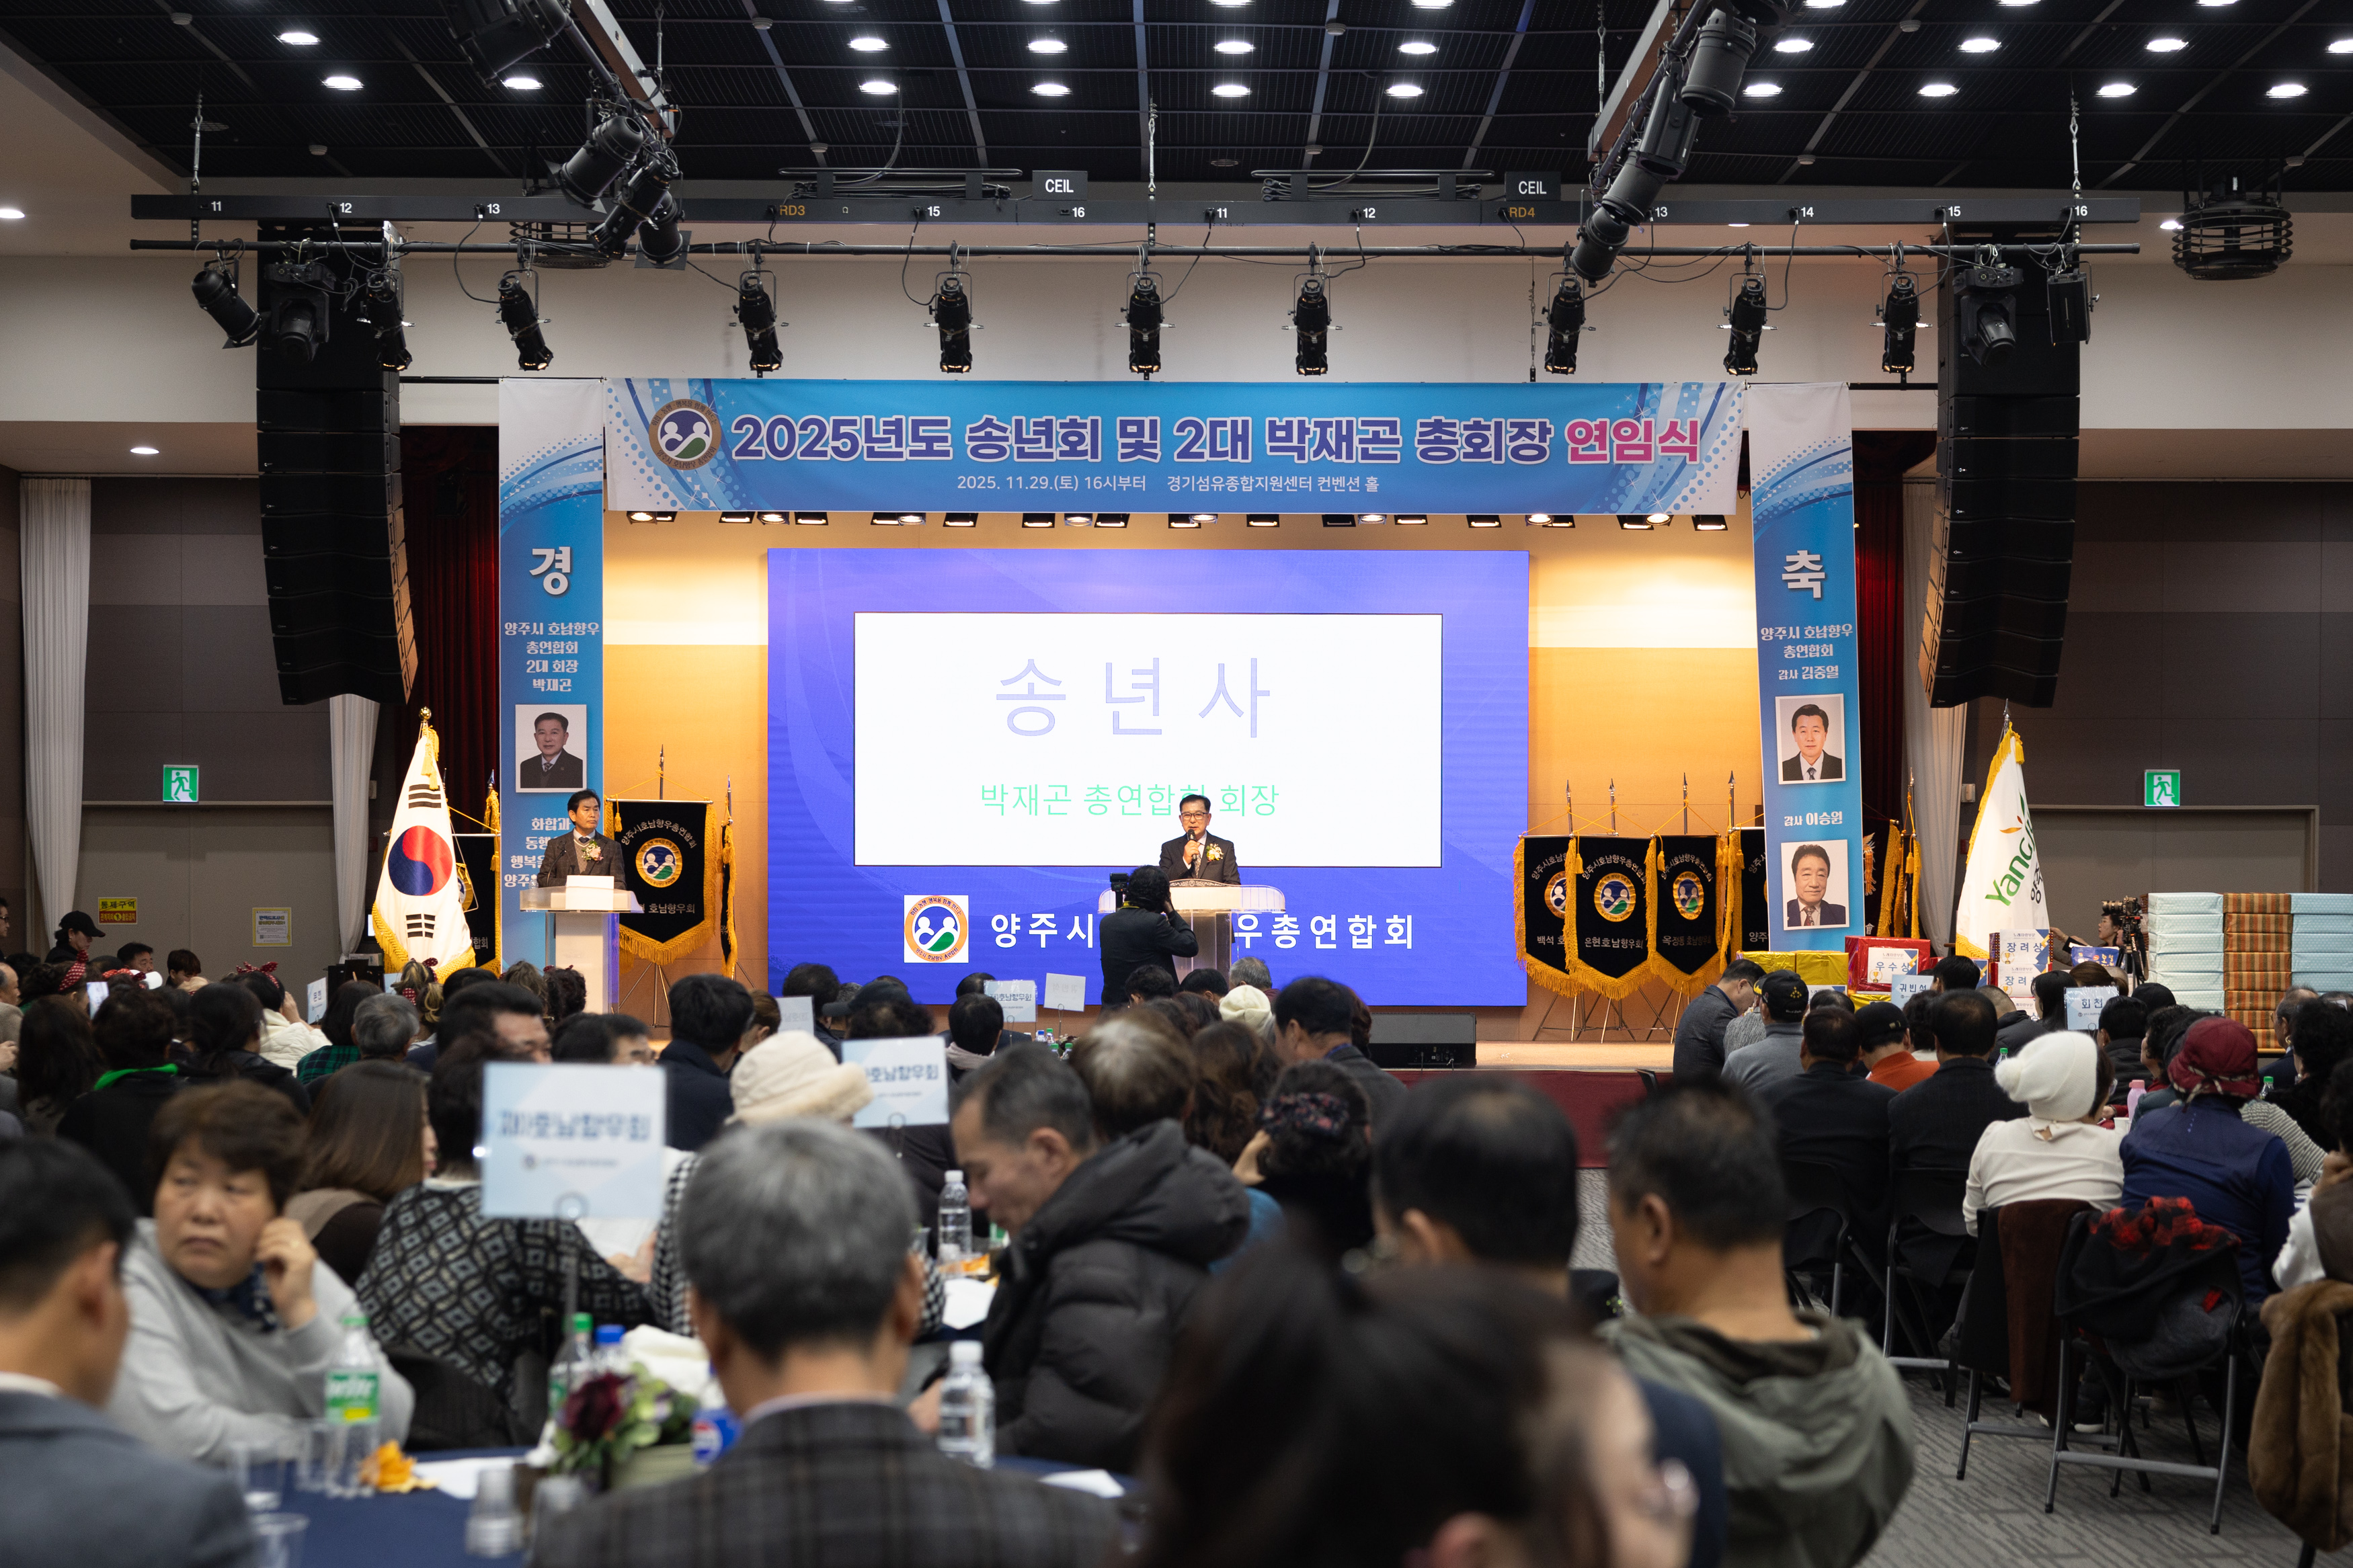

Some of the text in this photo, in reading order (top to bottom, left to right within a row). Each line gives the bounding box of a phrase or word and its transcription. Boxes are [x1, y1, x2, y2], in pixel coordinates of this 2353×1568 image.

[1045, 179, 1073, 194] CEIL
[1519, 180, 1547, 195] CEIL
[210, 202, 221, 212] 11
[340, 203, 352, 213] 12
[487, 204, 500, 214] 13
[780, 205, 805, 216] RD3
[927, 206, 940, 217] 15
[1072, 206, 1085, 217] 16
[1216, 207, 1228, 218] 11
[1363, 207, 1375, 218] 12
[1509, 206, 1536, 218] RD4
[1654, 206, 1668, 217] 13
[1800, 206, 1814, 217] 14
[1948, 206, 1961, 216] 15
[2075, 205, 2088, 216] 16
[732, 415, 1700, 465] 2025년도 송년회 및 2대 박재곤 총회장 연임식
[957, 474, 1380, 493] 2025. 11.29.(토) 16시부터 경기섬유종합지원센터 컨벤션 홀
[529, 546, 571, 595] 경
[1782, 550, 1825, 599] 축
[504, 622, 600, 636] 양주시 호남향우
[1760, 624, 1853, 641] 양주시 호남향우
[526, 641, 578, 655] 총연합회
[1783, 644, 1833, 659] 총연합회
[526, 659, 579, 673] 2대 회장
[1778, 665, 1839, 680] 감사 김중열
[532, 678, 572, 692] 박재곤
[980, 782, 1072, 817] 박재곤
[1218, 782, 1279, 817] 회장
[531, 817, 571, 831] 화합과
[1784, 811, 1843, 826] 감사 이승원
[525, 836, 557, 850] 동행
[504, 874, 538, 887] 양주
[991, 913, 1094, 950] 양주시
